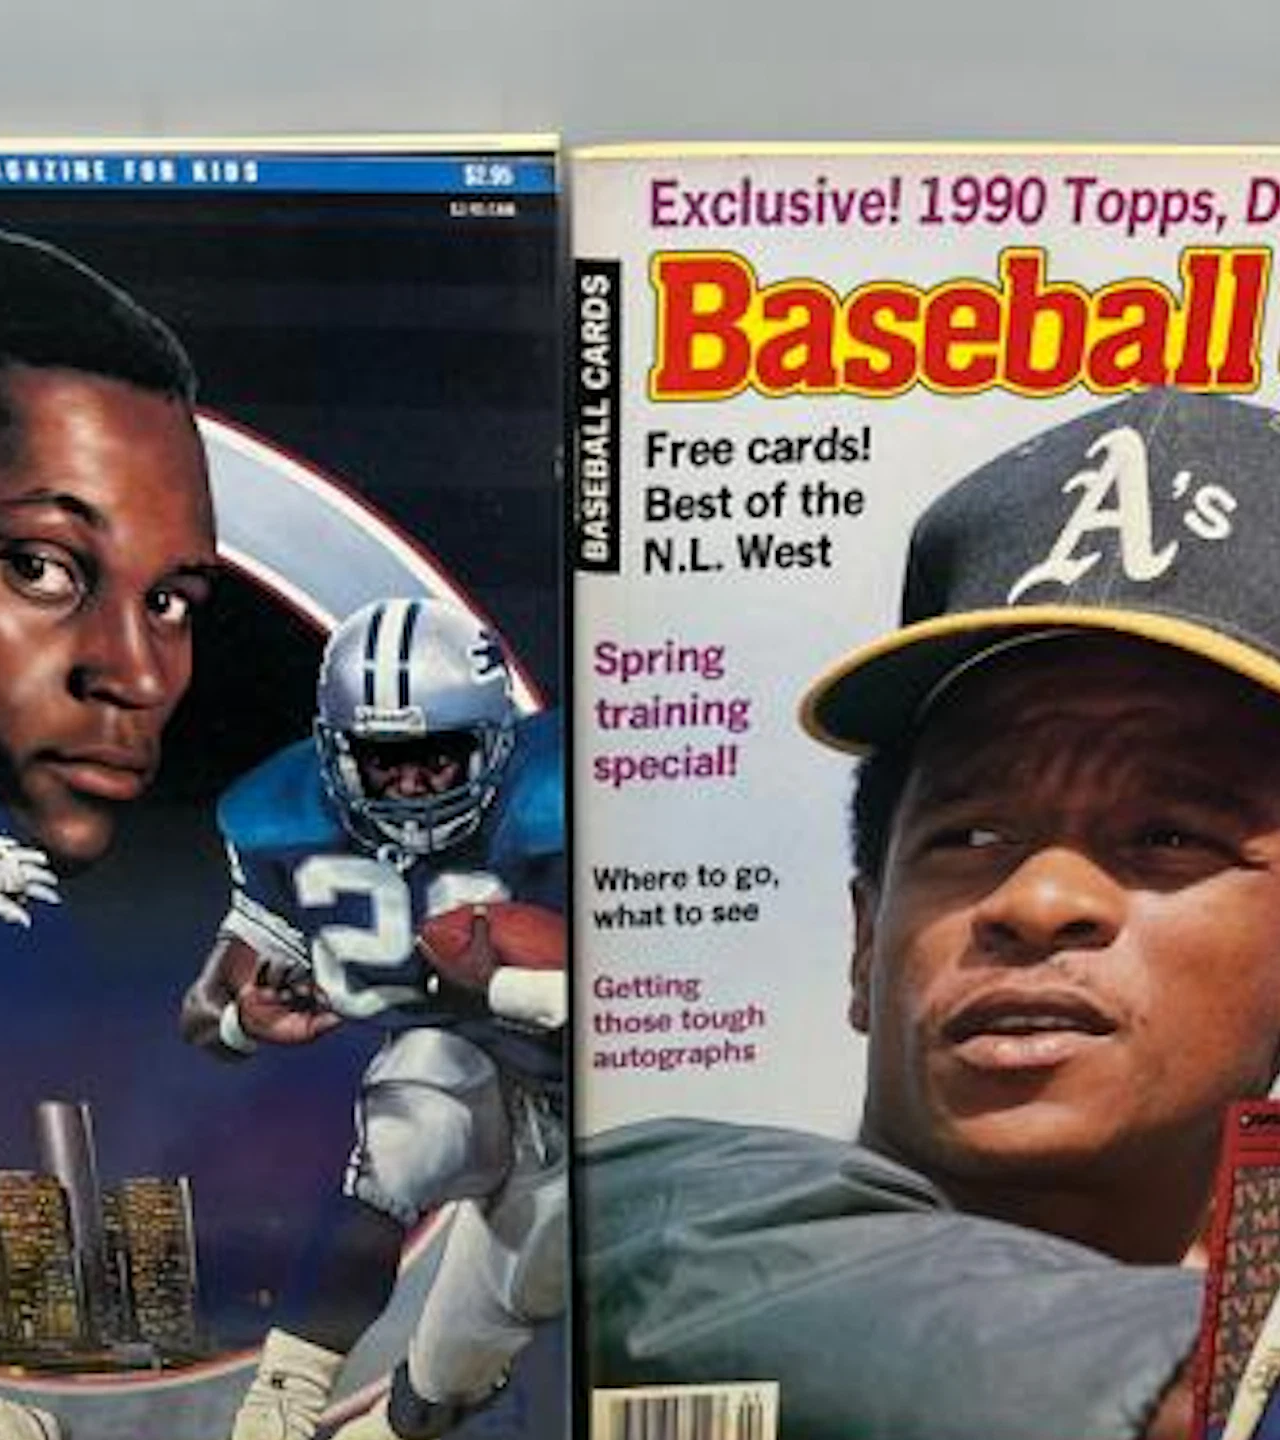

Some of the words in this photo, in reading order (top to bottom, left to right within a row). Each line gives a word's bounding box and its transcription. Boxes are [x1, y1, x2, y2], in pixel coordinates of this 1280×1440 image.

[649, 177, 902, 228] Exclusive!
[918, 176, 1048, 225] 1990
[1064, 176, 1229, 237] Topps,
[580, 272, 614, 391] CARDS
[648, 247, 1272, 400] Baseball
[645, 431, 735, 468] Free
[748, 427, 872, 466] cards!
[580, 397, 614, 563] BASEBALL
[645, 484, 733, 521] Best
[745, 482, 787, 518] of
[801, 482, 865, 516] the
[1007, 425, 1239, 605] A's
[643, 537, 726, 575] N.L.
[736, 533, 832, 570] West
[593, 641, 726, 683] Spring
[594, 693, 752, 733] training
[593, 744, 738, 788] special!
[593, 866, 687, 893] Where
[697, 864, 726, 888] to
[734, 864, 779, 893] go,
[593, 901, 666, 929] what
[674, 900, 704, 926] to
[711, 900, 760, 923] see
[593, 974, 702, 1001] Getting
[594, 1010, 672, 1035] those
[681, 1004, 766, 1032] tough
[593, 1040, 757, 1071] autographs
